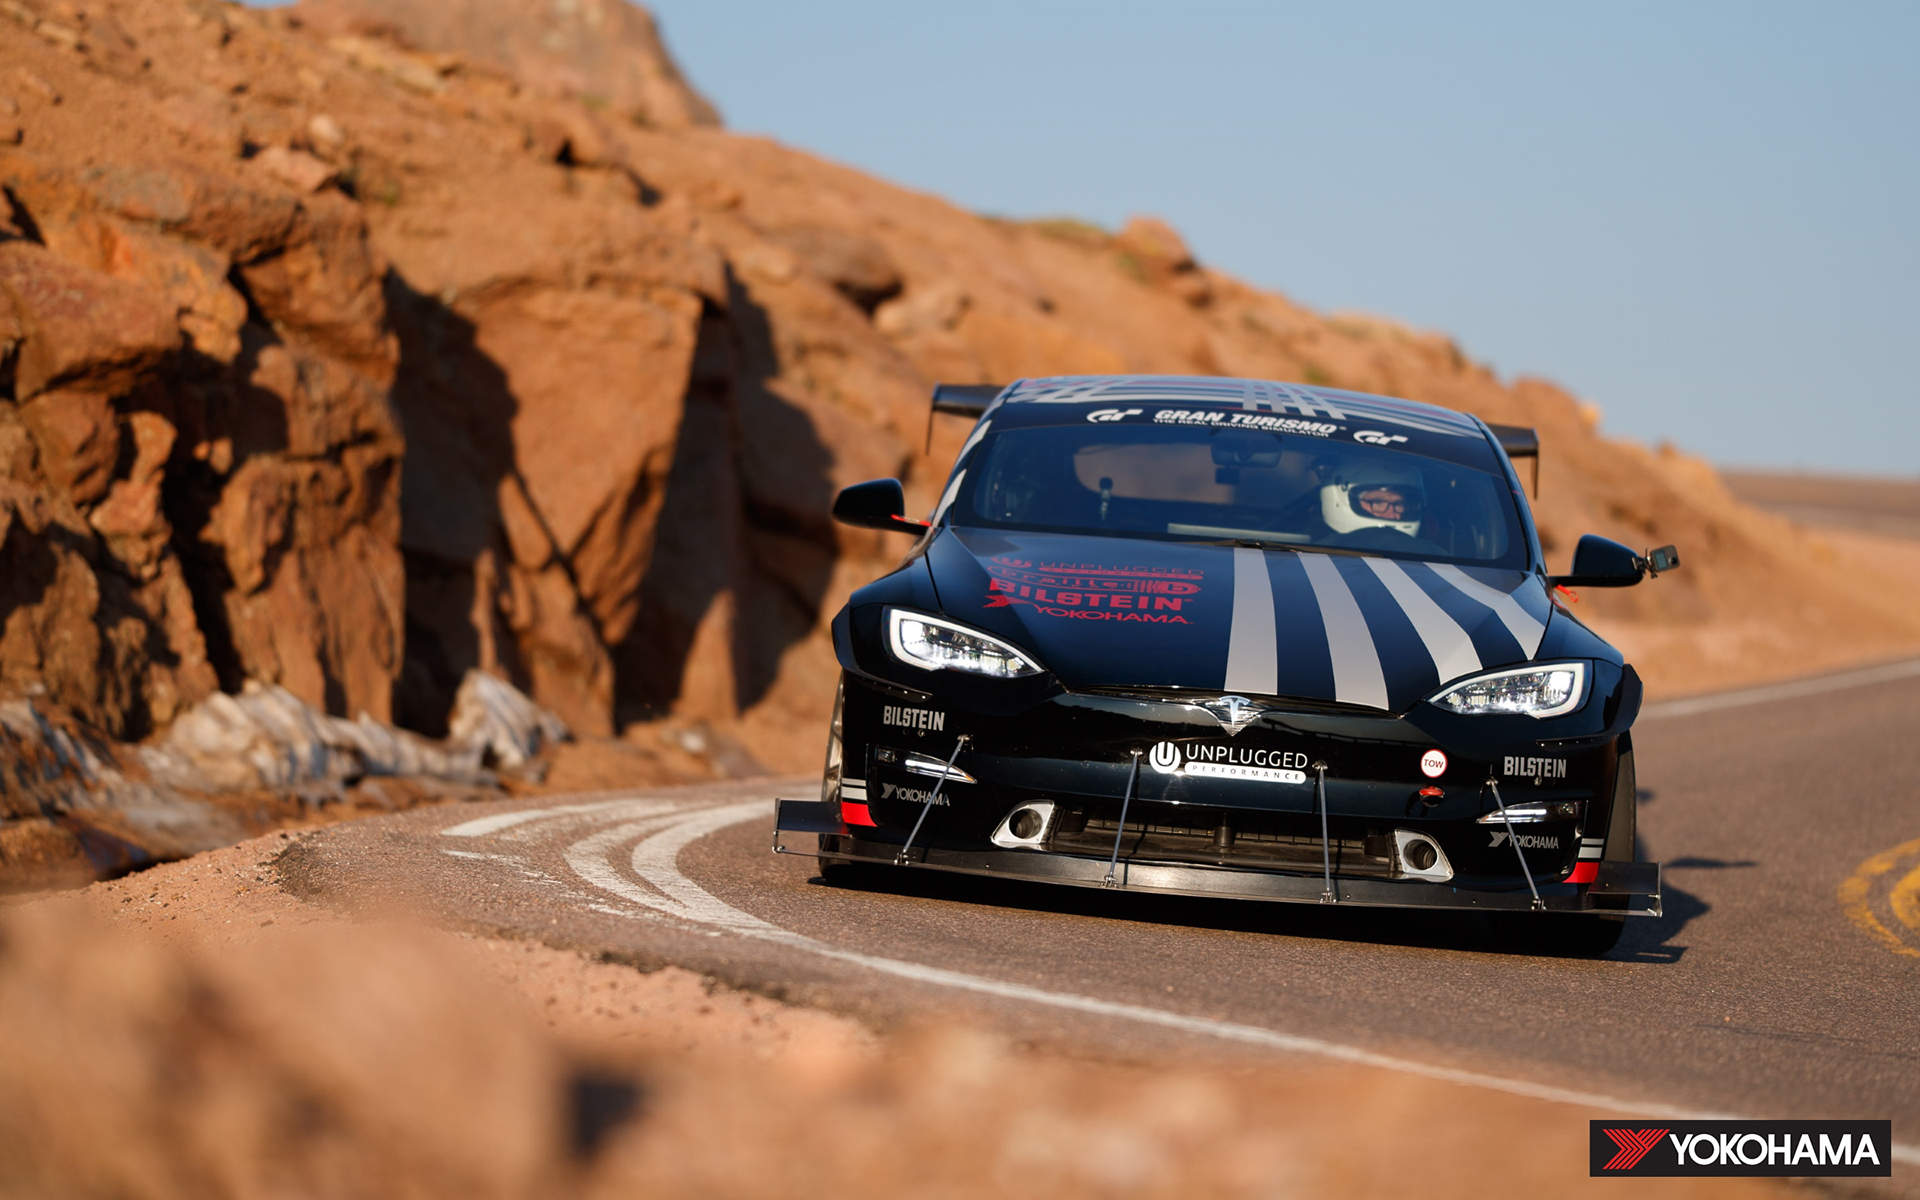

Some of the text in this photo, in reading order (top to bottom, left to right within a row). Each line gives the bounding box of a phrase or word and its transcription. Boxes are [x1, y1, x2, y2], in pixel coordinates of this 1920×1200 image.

[1155, 409, 1338, 434] GRAN TURISMO
[1211, 421, 1259, 430] DRIVING
[1261, 425, 1330, 438] SIMULATOR
[1039, 560, 1205, 576] UNPLUGGED
[989, 577, 1183, 611] BILSTEIN
[1033, 604, 1189, 625] YOKOHAMA
[883, 705, 946, 732] BILSTEIN
[1185, 743, 1309, 769] UNPLUGGED
[1423, 759, 1444, 769] TOW
[1192, 765, 1300, 781] PERFORMANCE
[1503, 756, 1567, 778] BILSTEIN
[895, 787, 951, 807] YOKOHAMA
[1508, 833, 1560, 850] YOKOHAMA
